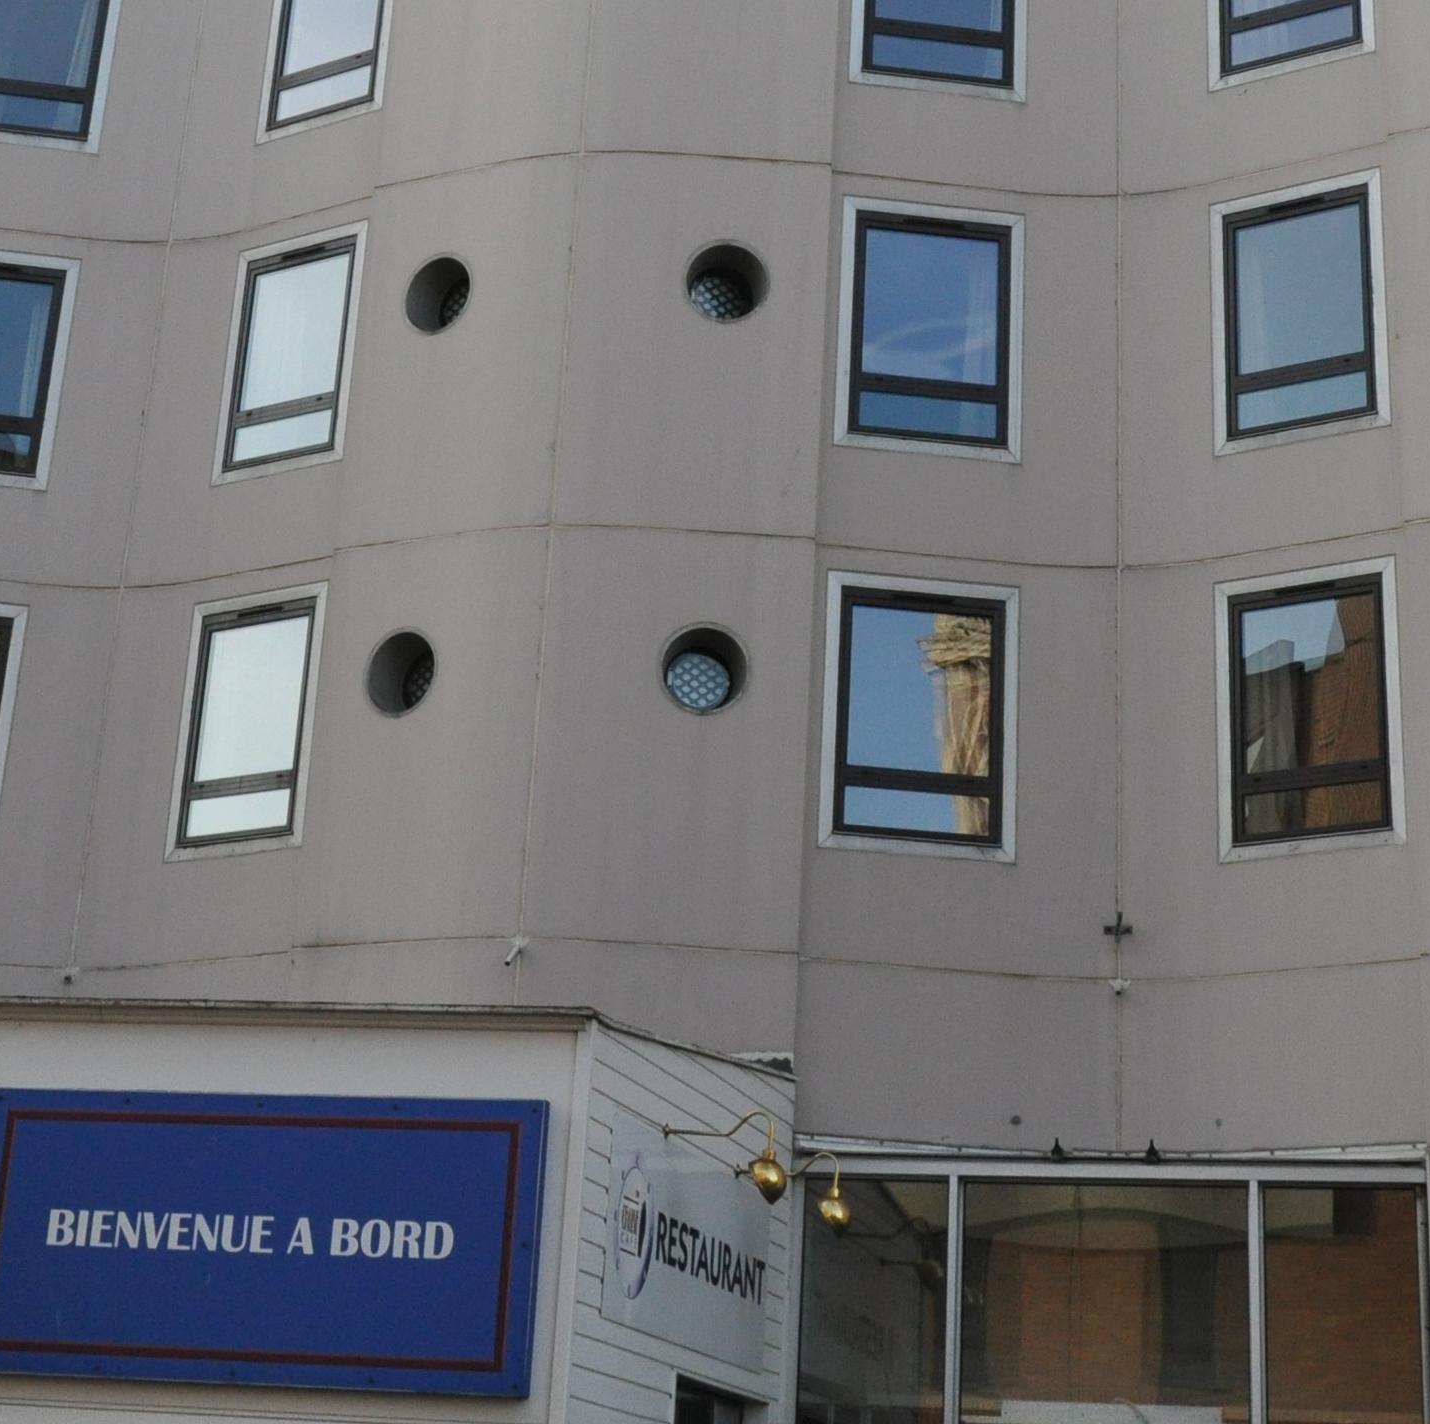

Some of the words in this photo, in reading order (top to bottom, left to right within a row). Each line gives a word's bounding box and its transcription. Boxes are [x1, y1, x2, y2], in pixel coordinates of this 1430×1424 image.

[46, 1208, 275, 1254] BIENVENUE
[286, 1217, 314, 1255] A
[329, 1218, 455, 1260] BORD
[655, 1211, 767, 1306] RESTAURANT
